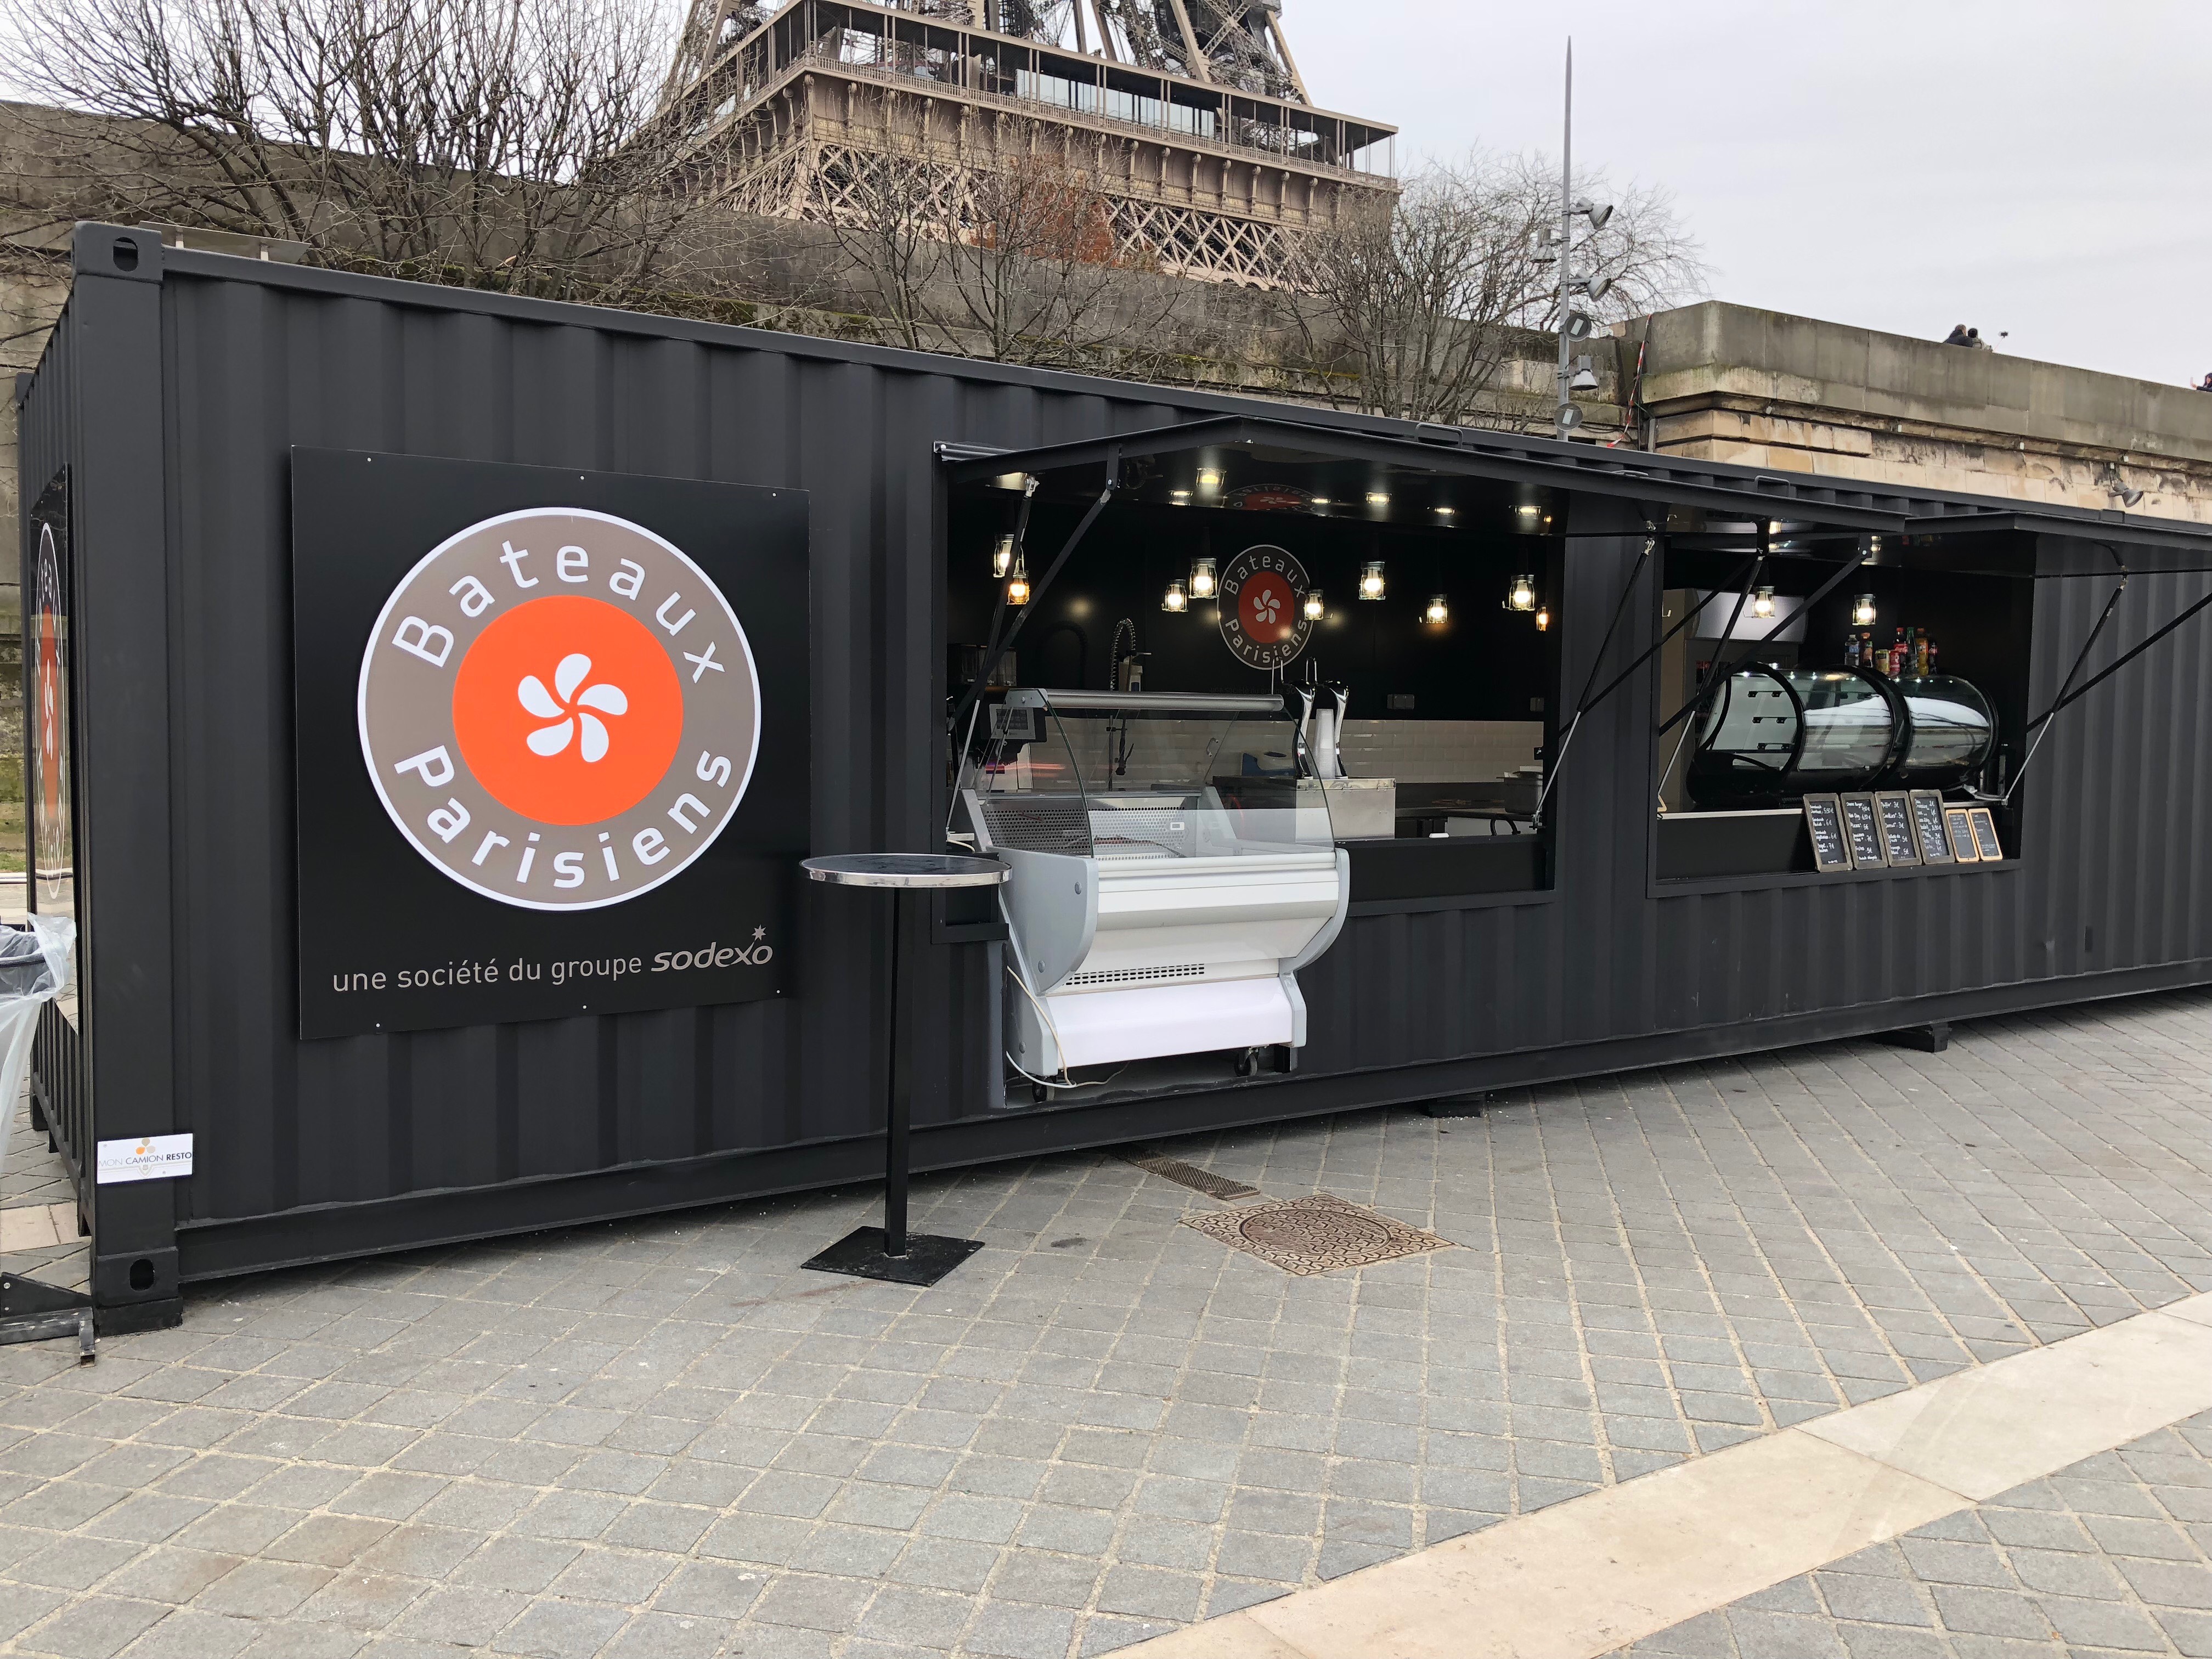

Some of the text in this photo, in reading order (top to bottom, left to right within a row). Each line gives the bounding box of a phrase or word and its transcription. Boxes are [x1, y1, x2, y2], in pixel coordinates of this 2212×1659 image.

[1224, 555, 1307, 599] Bateaux
[392, 539, 726, 683] Bateaux
[1225, 618, 1307, 663] Parisiens
[393, 744, 732, 888] Parisiens
[333, 939, 773, 992] une société du groupe sodexo
[98, 1152, 192, 1167] MON CAMION RESTO
